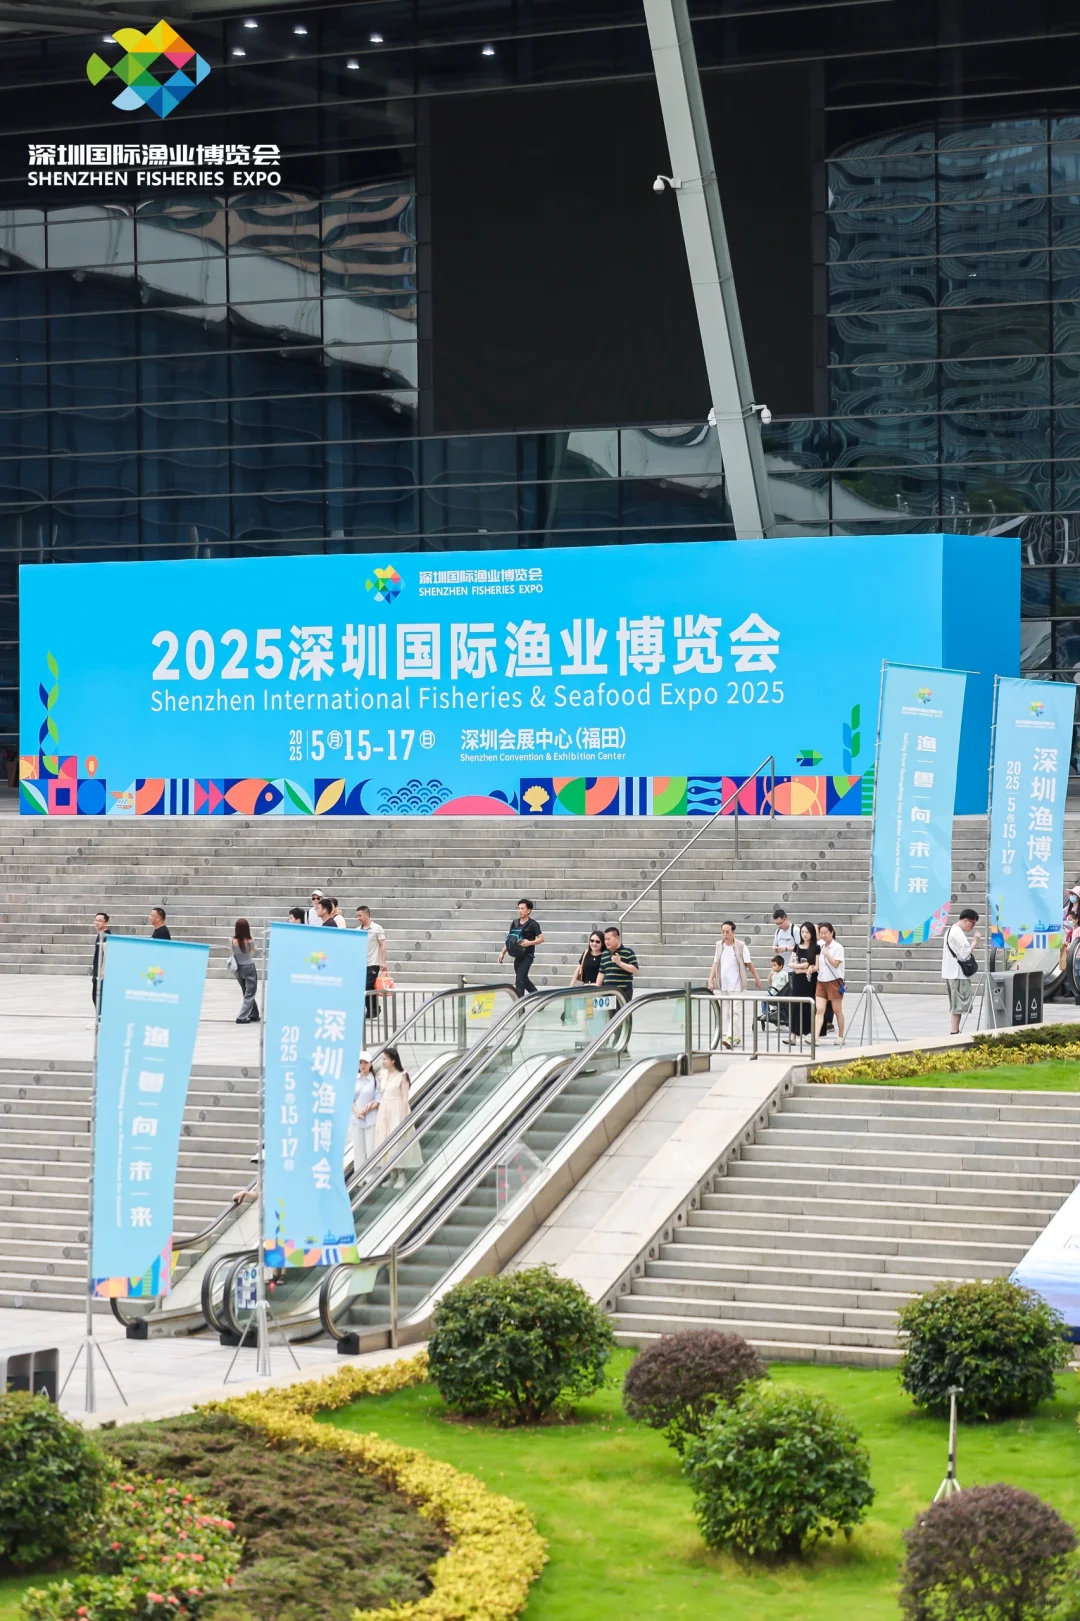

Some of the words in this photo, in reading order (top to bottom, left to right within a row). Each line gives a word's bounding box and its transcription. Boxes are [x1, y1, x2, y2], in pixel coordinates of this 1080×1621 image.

[419, 587, 468, 597] SHENZHEN
[472, 585, 515, 595] FISHERIES
[519, 584, 543, 593] EXPO
[151, 613, 782, 682] 2025深圳国际渔业博览会
[151, 689, 255, 712] Shenzhen
[264, 685, 410, 711] International
[419, 684, 522, 709] Fisheries
[530, 686, 546, 708] &
[554, 682, 650, 708] Seafood
[661, 683, 718, 711] Expo
[727, 681, 785, 705] 2025
[460, 753, 498, 762] Shenzhen
[499, 753, 544, 762] Convention
[545, 752, 552, 761] &
[553, 751, 596, 761] Exhibition
[597, 750, 626, 761] Center
[1026, 746, 1058, 889] 深圳渔博会
[311, 1007, 347, 1190] 深圳渔博会
